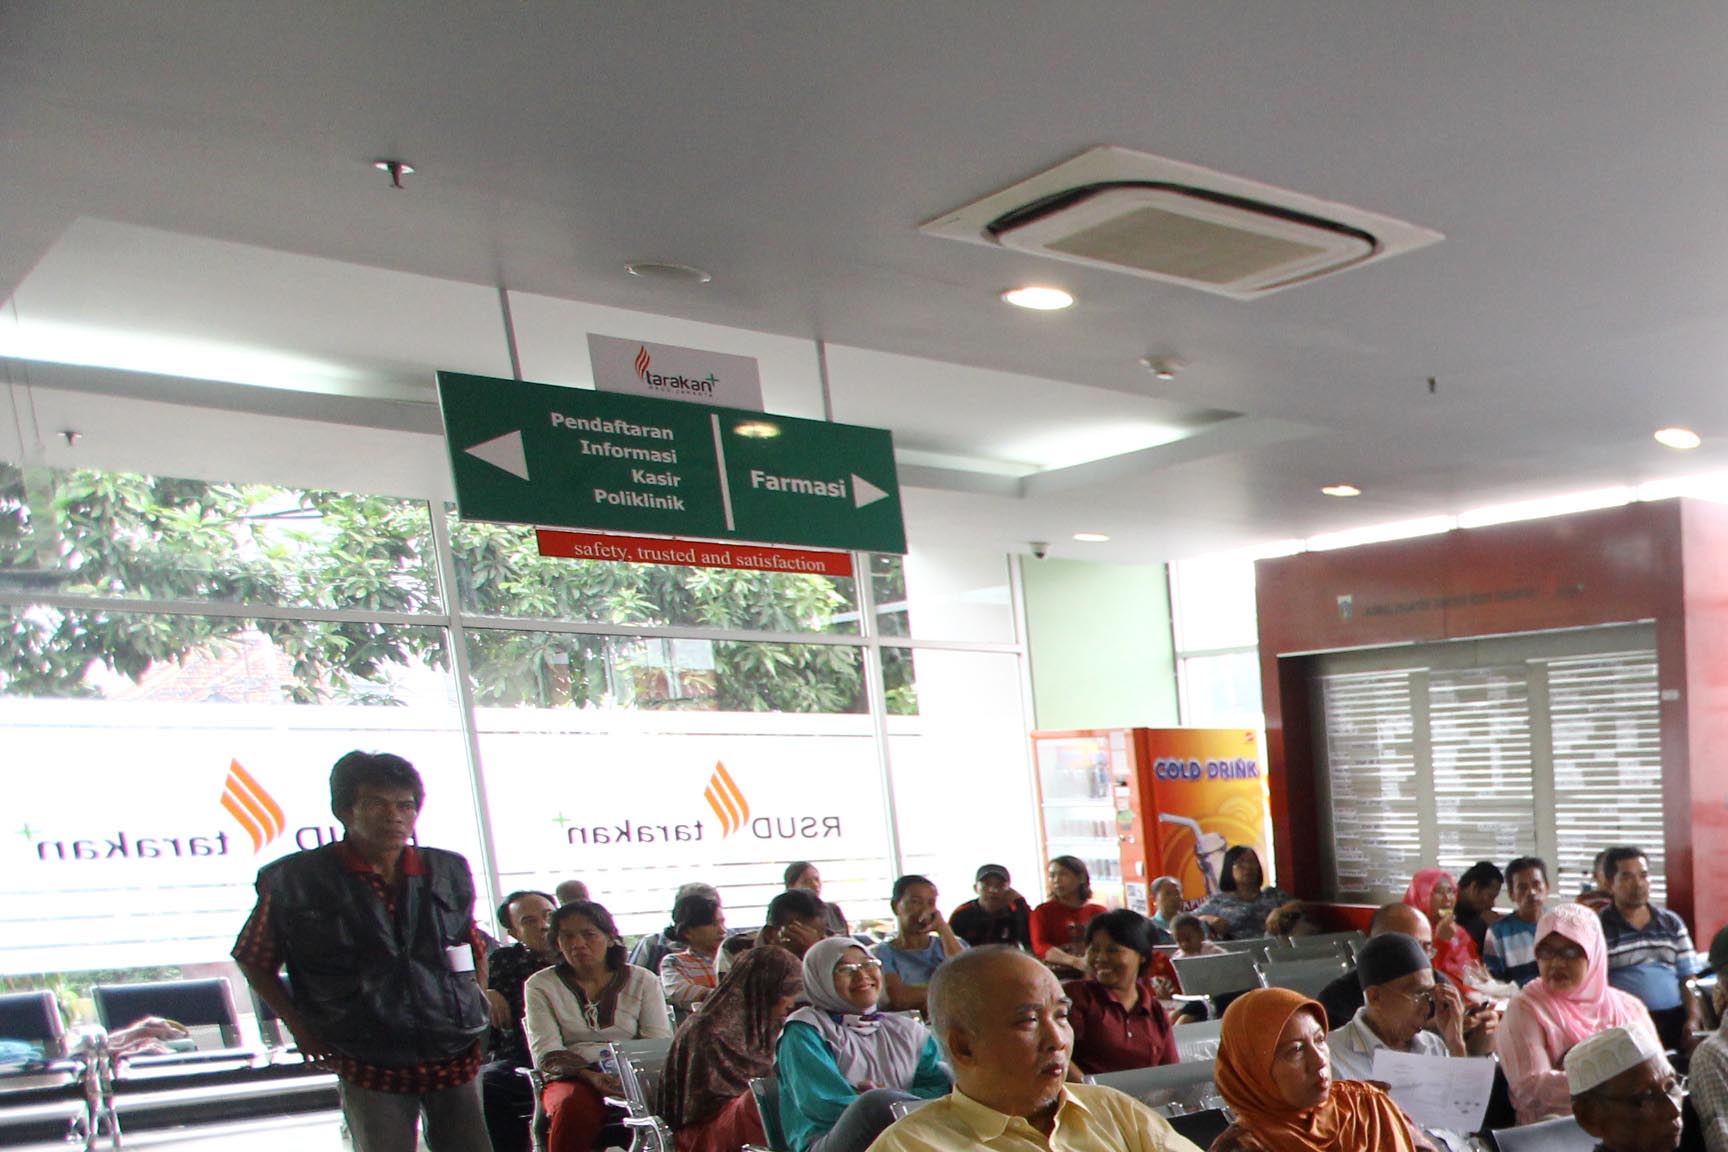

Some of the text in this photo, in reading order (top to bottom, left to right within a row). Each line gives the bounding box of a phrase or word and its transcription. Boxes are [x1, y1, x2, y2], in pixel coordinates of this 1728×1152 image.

[646, 370, 713, 393] tarakan
[550, 412, 675, 441] Pendaftaran
[580, 440, 678, 464] Informasi
[631, 469, 682, 488] Kasir
[750, 469, 847, 498] Farmasi
[594, 488, 686, 511] Poliklinik
[574, 542, 827, 572] safety, trusted and satisfaction
[1154, 757, 1259, 780] COLD DRINK
